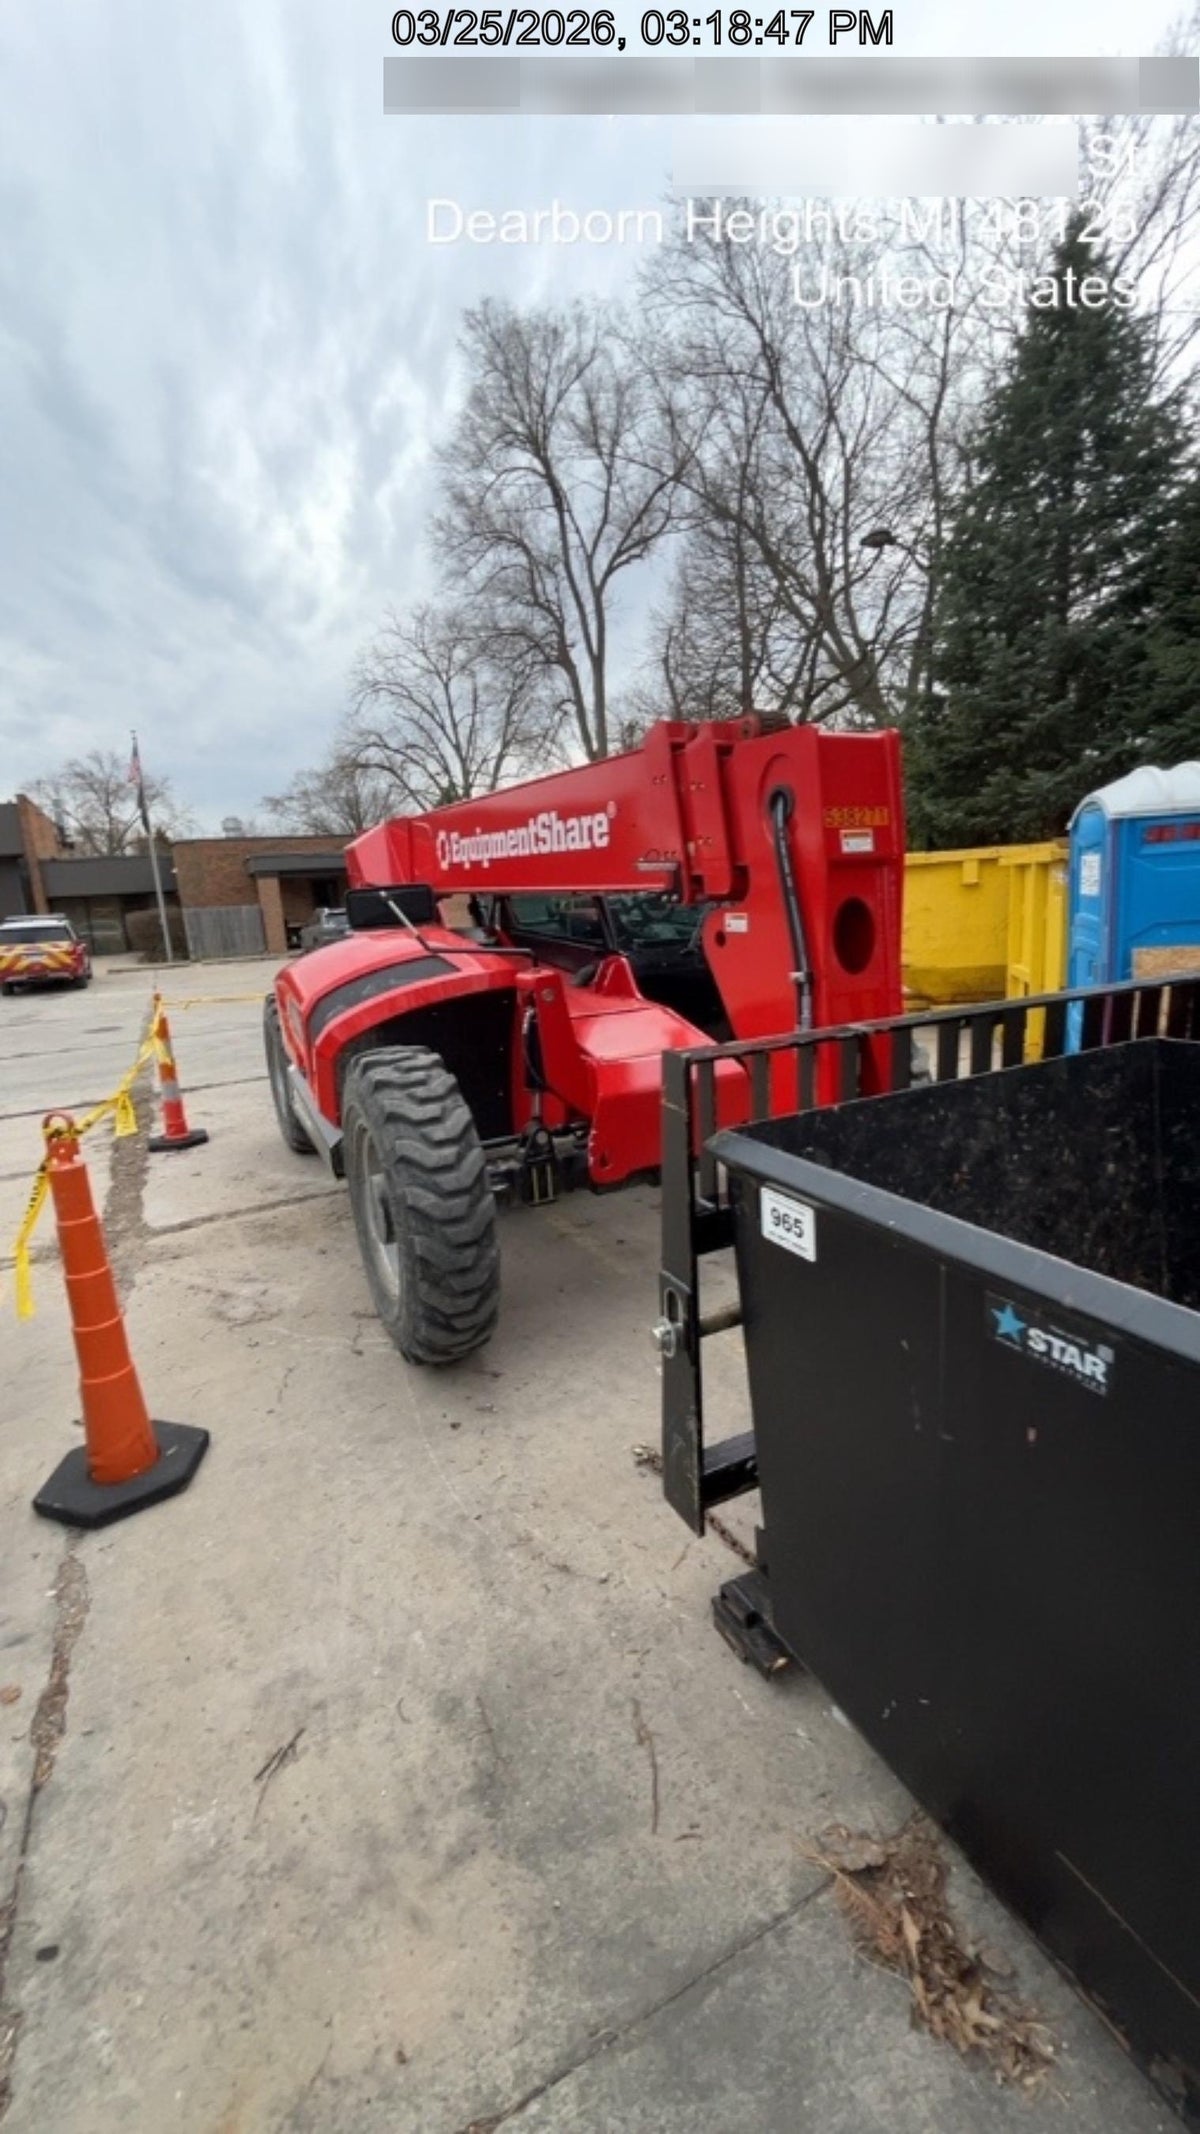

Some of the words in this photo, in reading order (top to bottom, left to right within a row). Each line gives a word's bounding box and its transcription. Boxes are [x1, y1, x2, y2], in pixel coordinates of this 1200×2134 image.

[451, 810, 610, 868] EquipmentShare
[770, 1206, 805, 1239] 965
[1027, 1326, 1108, 1384] STAR
